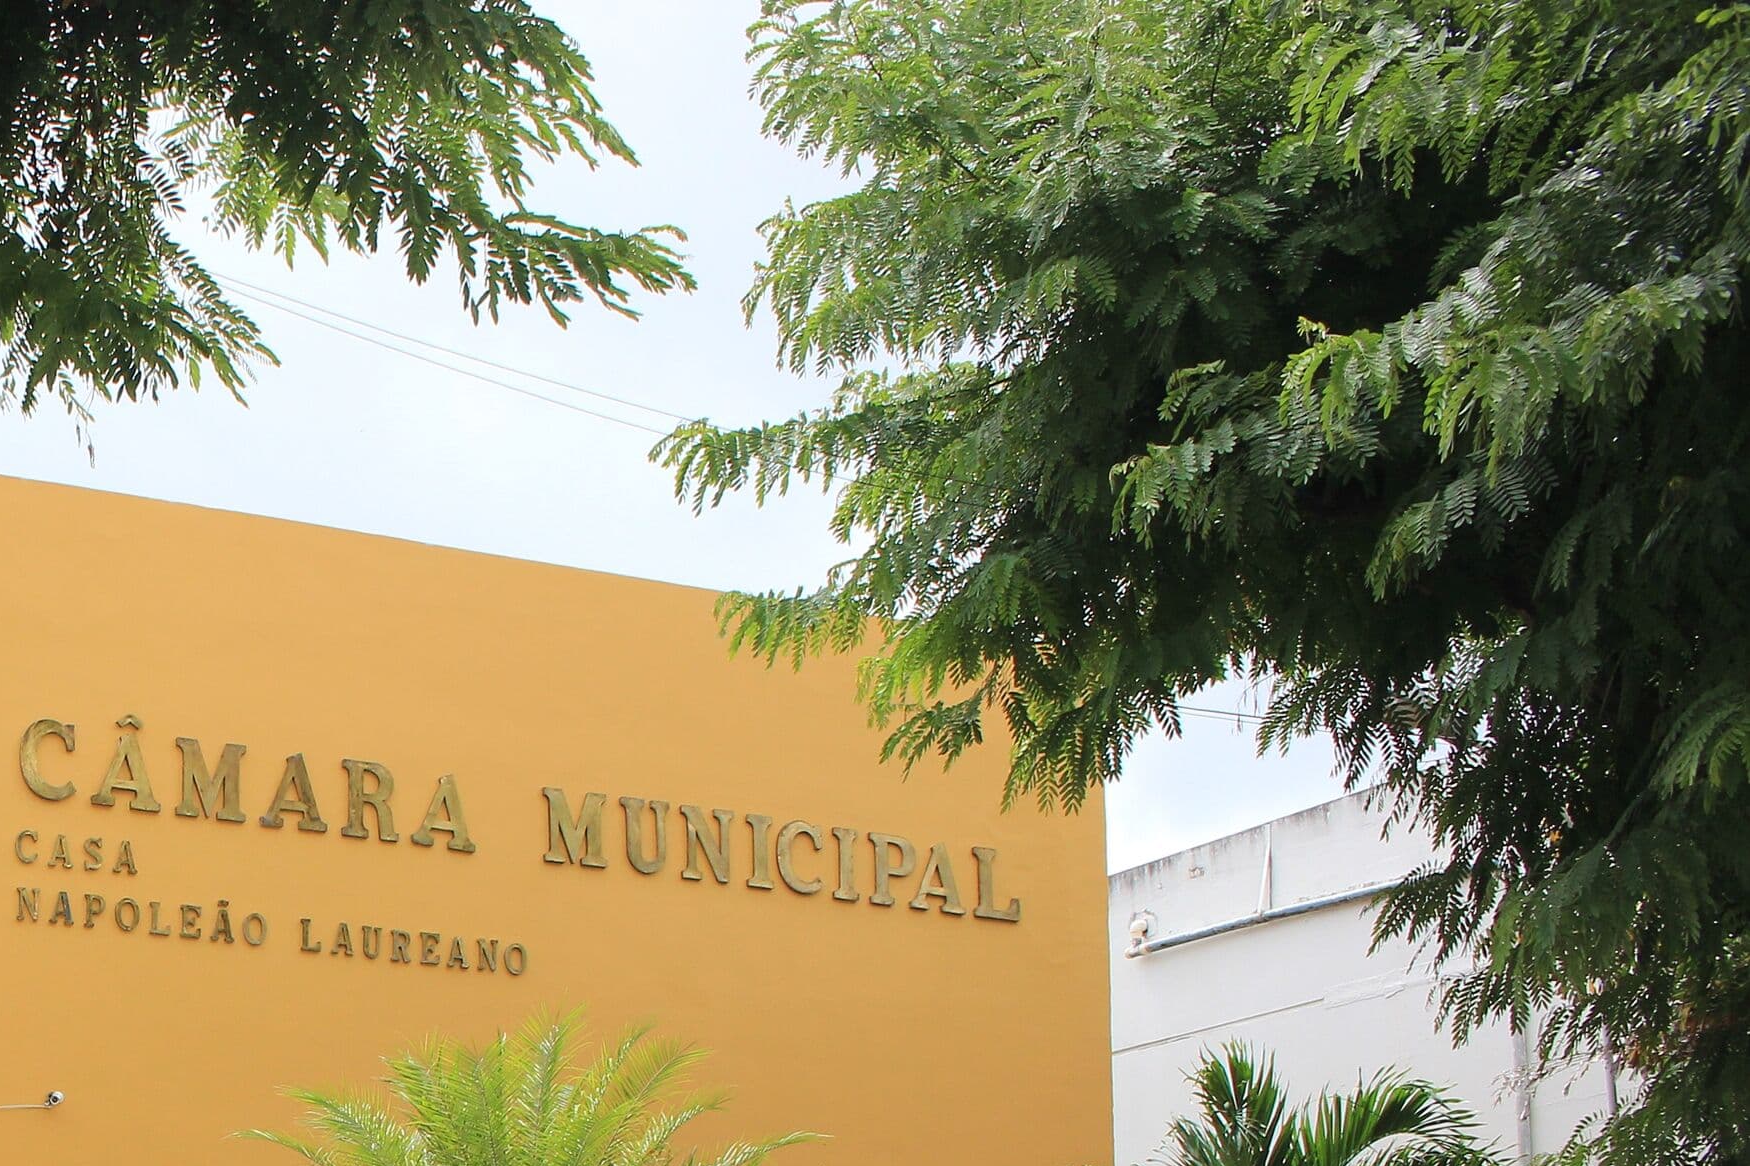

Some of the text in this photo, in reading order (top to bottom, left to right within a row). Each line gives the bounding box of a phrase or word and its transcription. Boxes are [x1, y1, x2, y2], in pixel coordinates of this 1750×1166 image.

[14, 830, 140, 875] CASA
[19, 714, 1022, 922] CÂMARA MUNICIPAL
[15, 886, 528, 976] NAPOLEÃO LAUREANO
